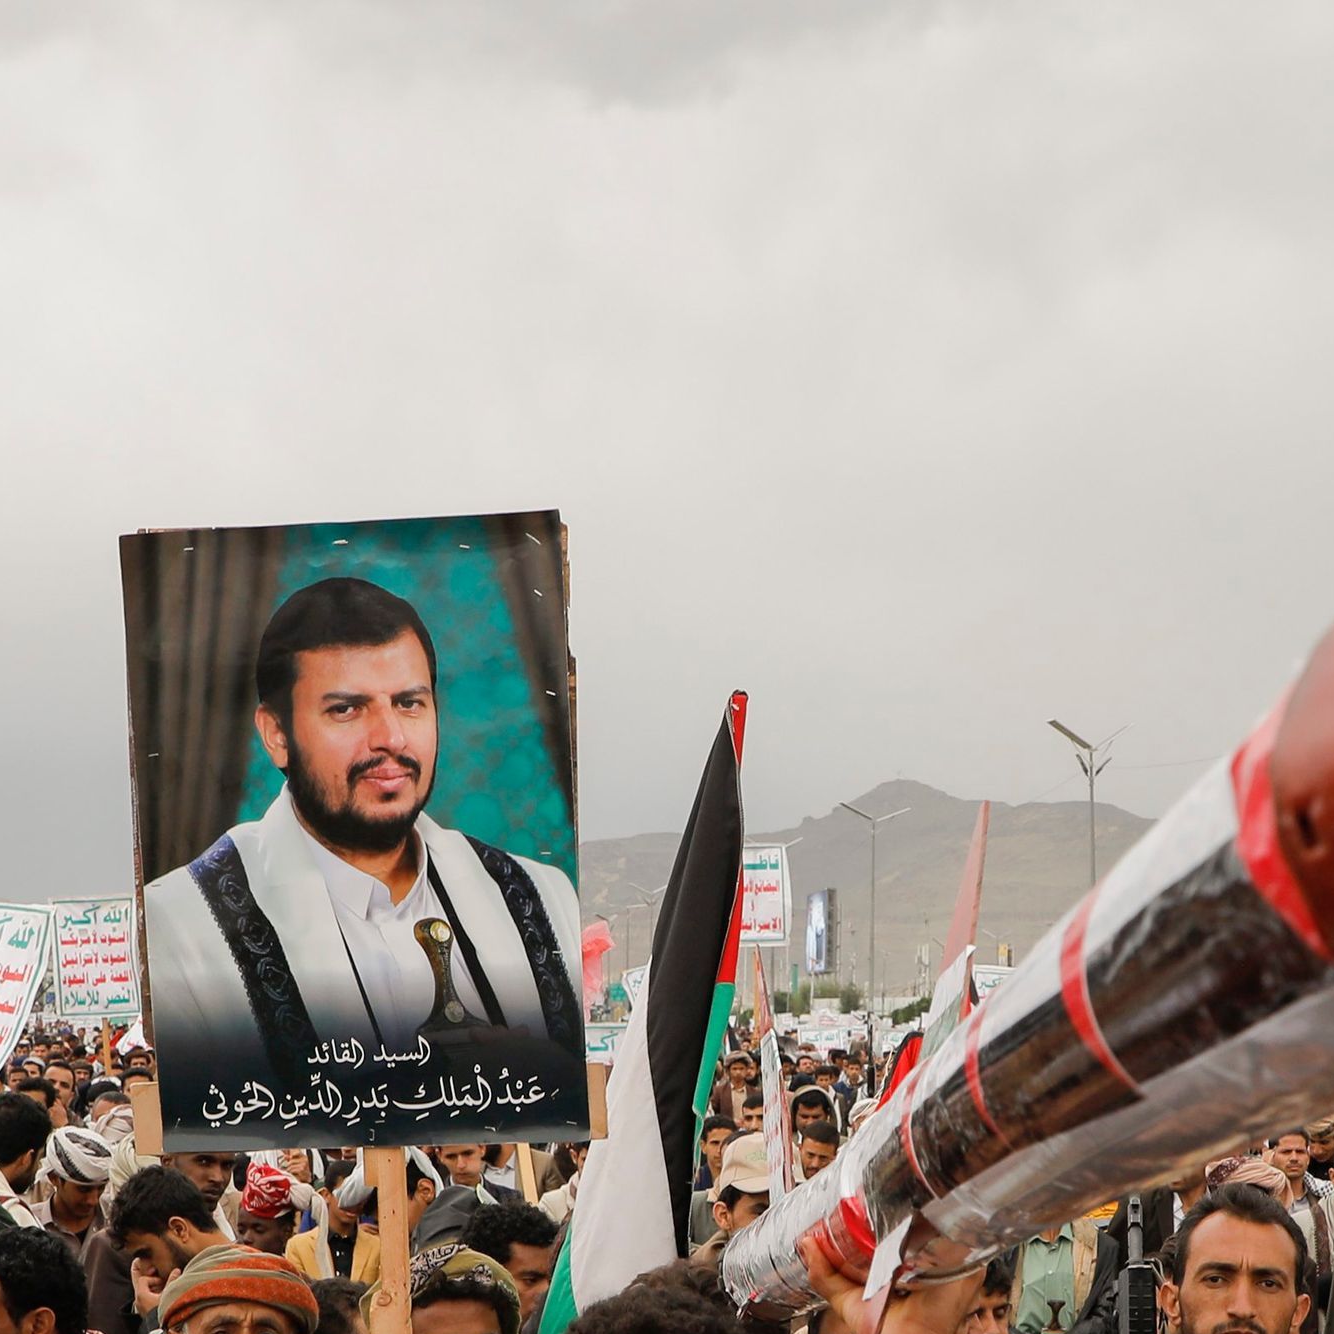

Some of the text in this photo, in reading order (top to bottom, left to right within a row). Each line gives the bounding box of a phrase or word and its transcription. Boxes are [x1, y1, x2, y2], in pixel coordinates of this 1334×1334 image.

[744, 854, 779, 870] قاط
[307, 1035, 431, 1070] السيد القائد
